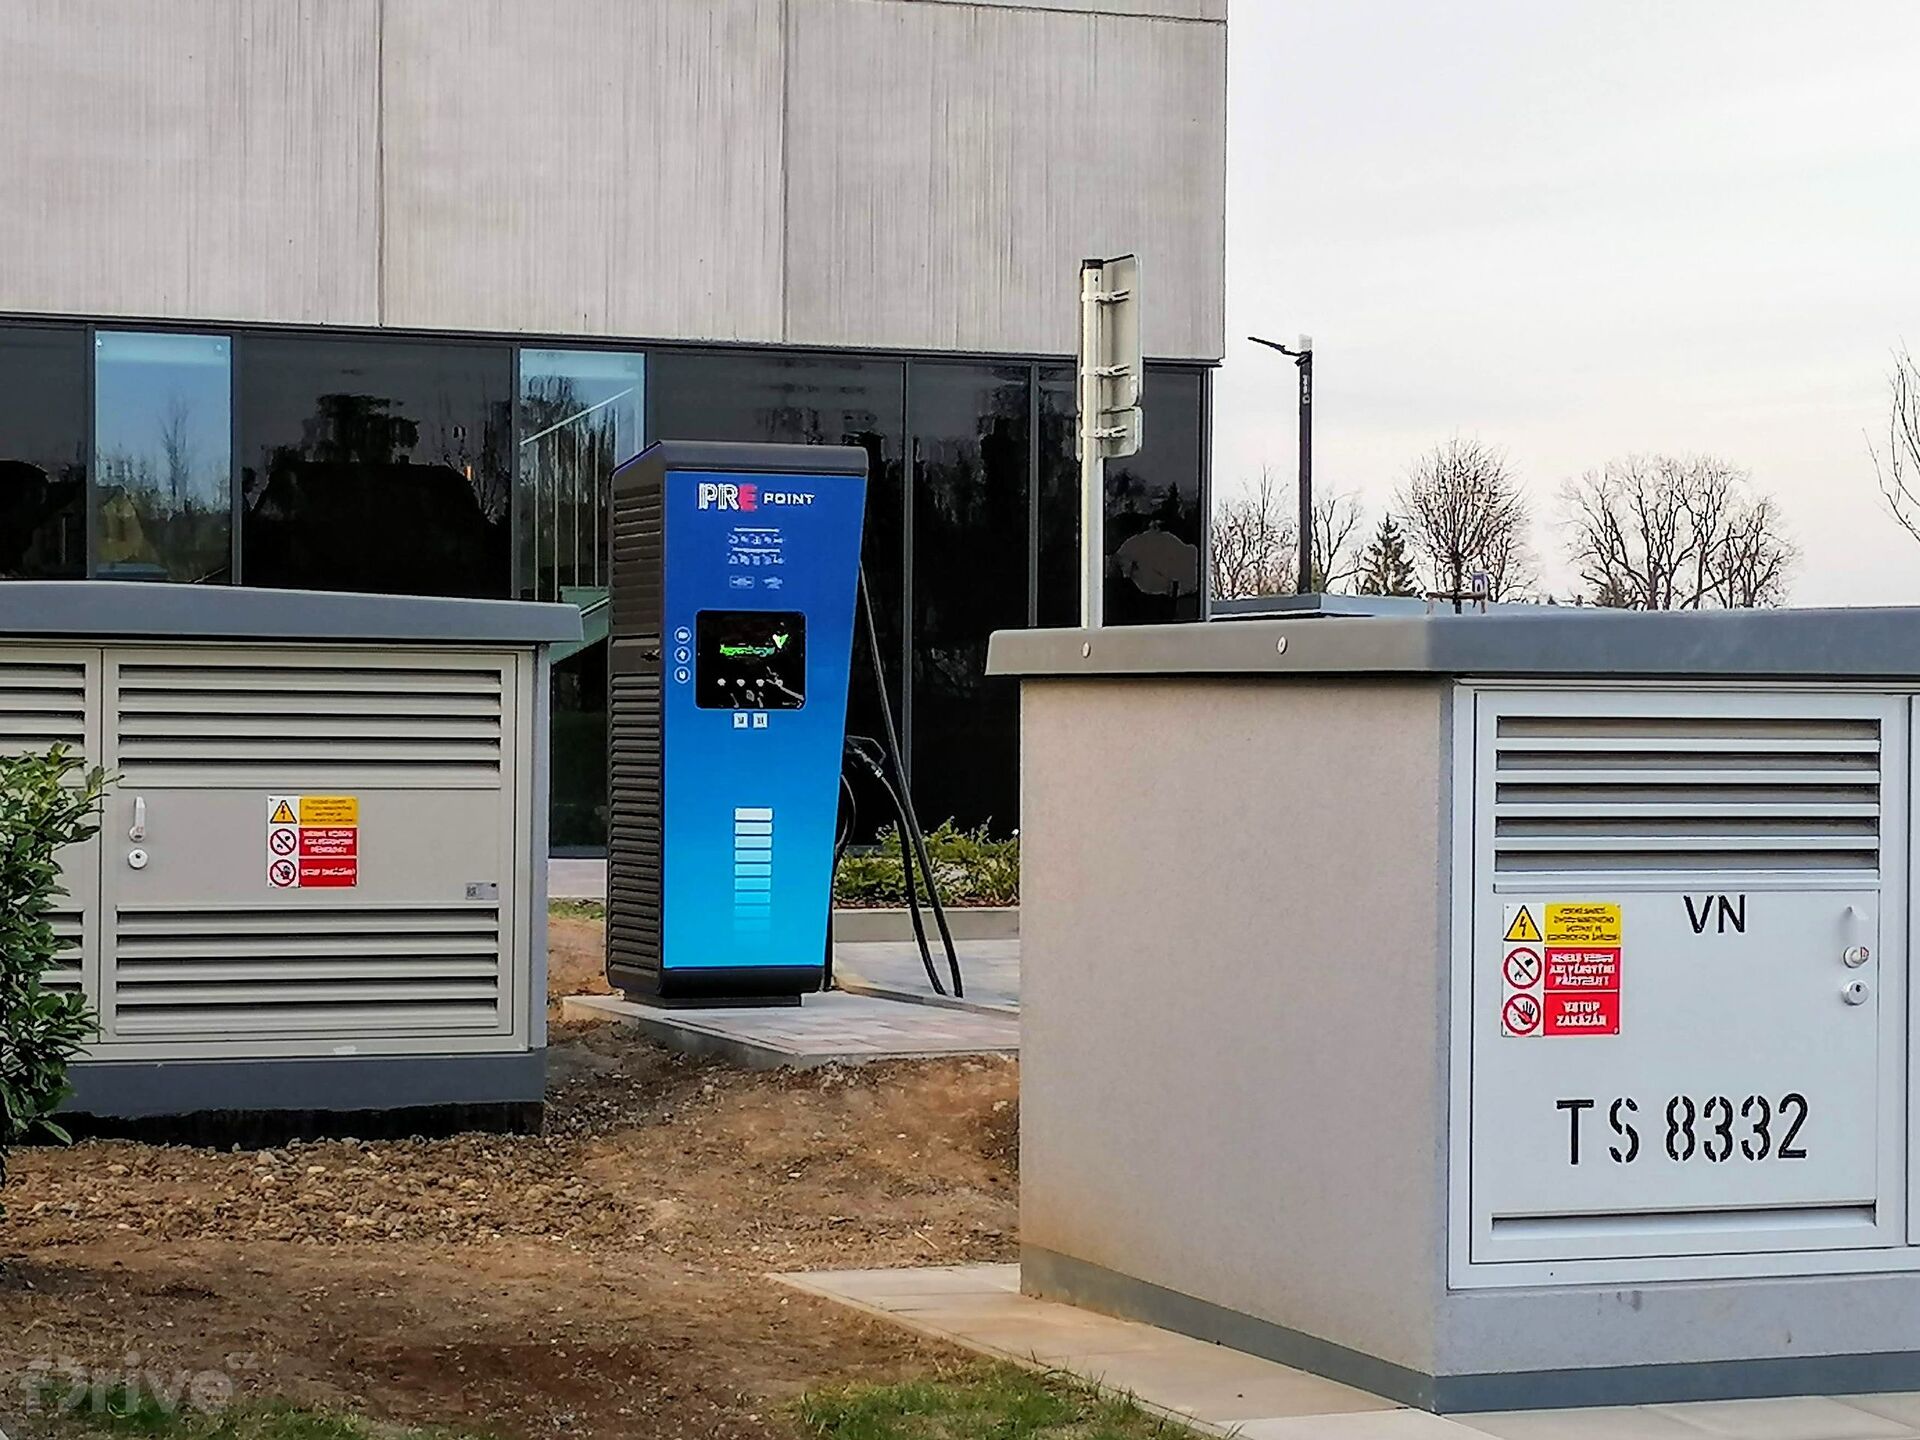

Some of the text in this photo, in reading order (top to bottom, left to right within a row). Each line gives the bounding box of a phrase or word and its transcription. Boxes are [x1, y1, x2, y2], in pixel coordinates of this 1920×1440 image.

[698, 483, 815, 511] PRE POINT
[1683, 894, 1745, 933] VN
[1666, 1093, 1808, 1162] 8332
